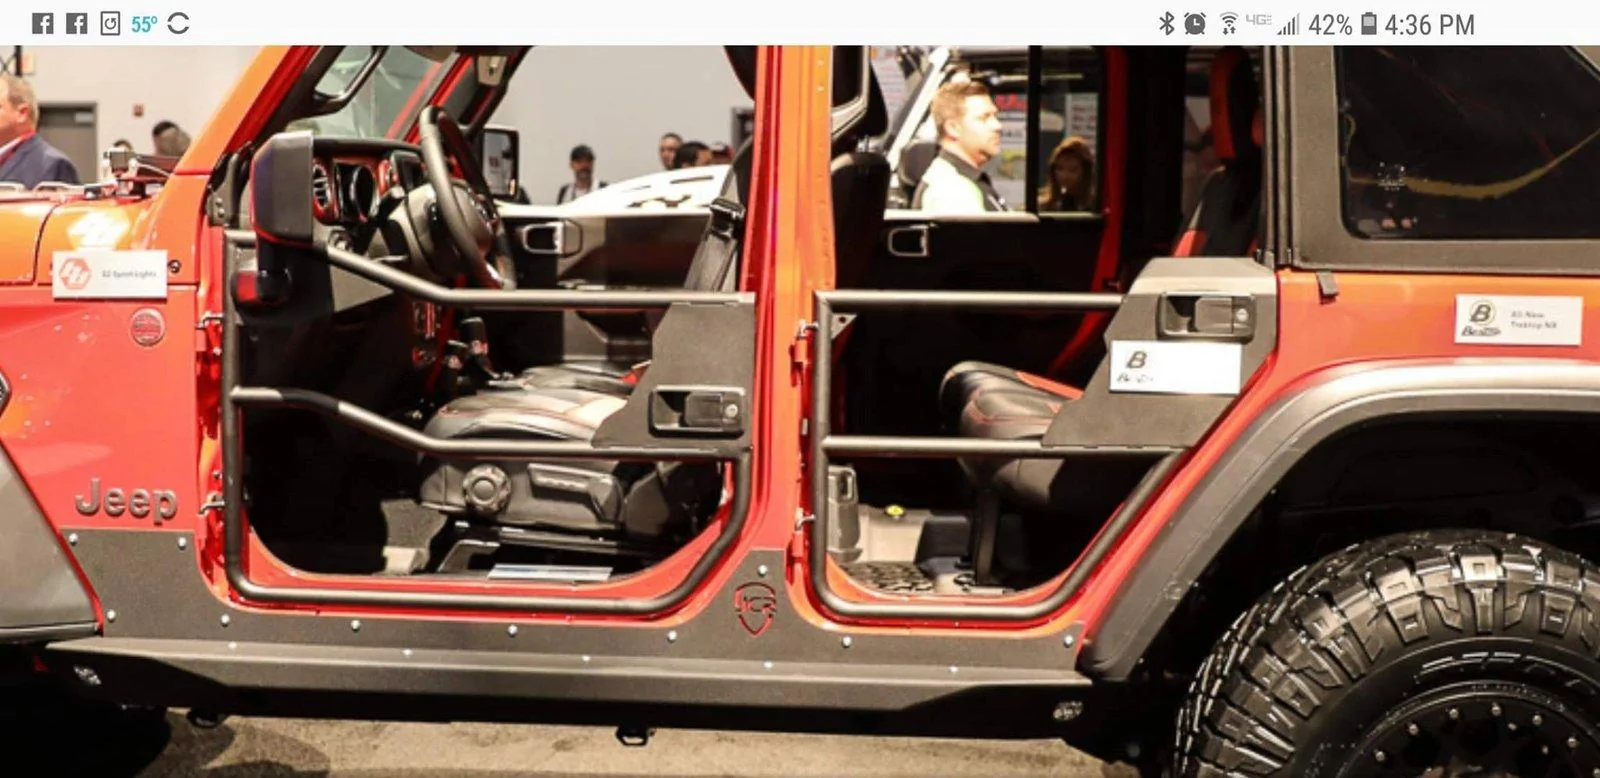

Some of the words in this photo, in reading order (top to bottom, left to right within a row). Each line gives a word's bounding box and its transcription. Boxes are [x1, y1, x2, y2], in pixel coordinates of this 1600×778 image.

[1470, 303, 1491, 322] B
[1126, 351, 1148, 369] B
[75, 478, 178, 526] Jeep
